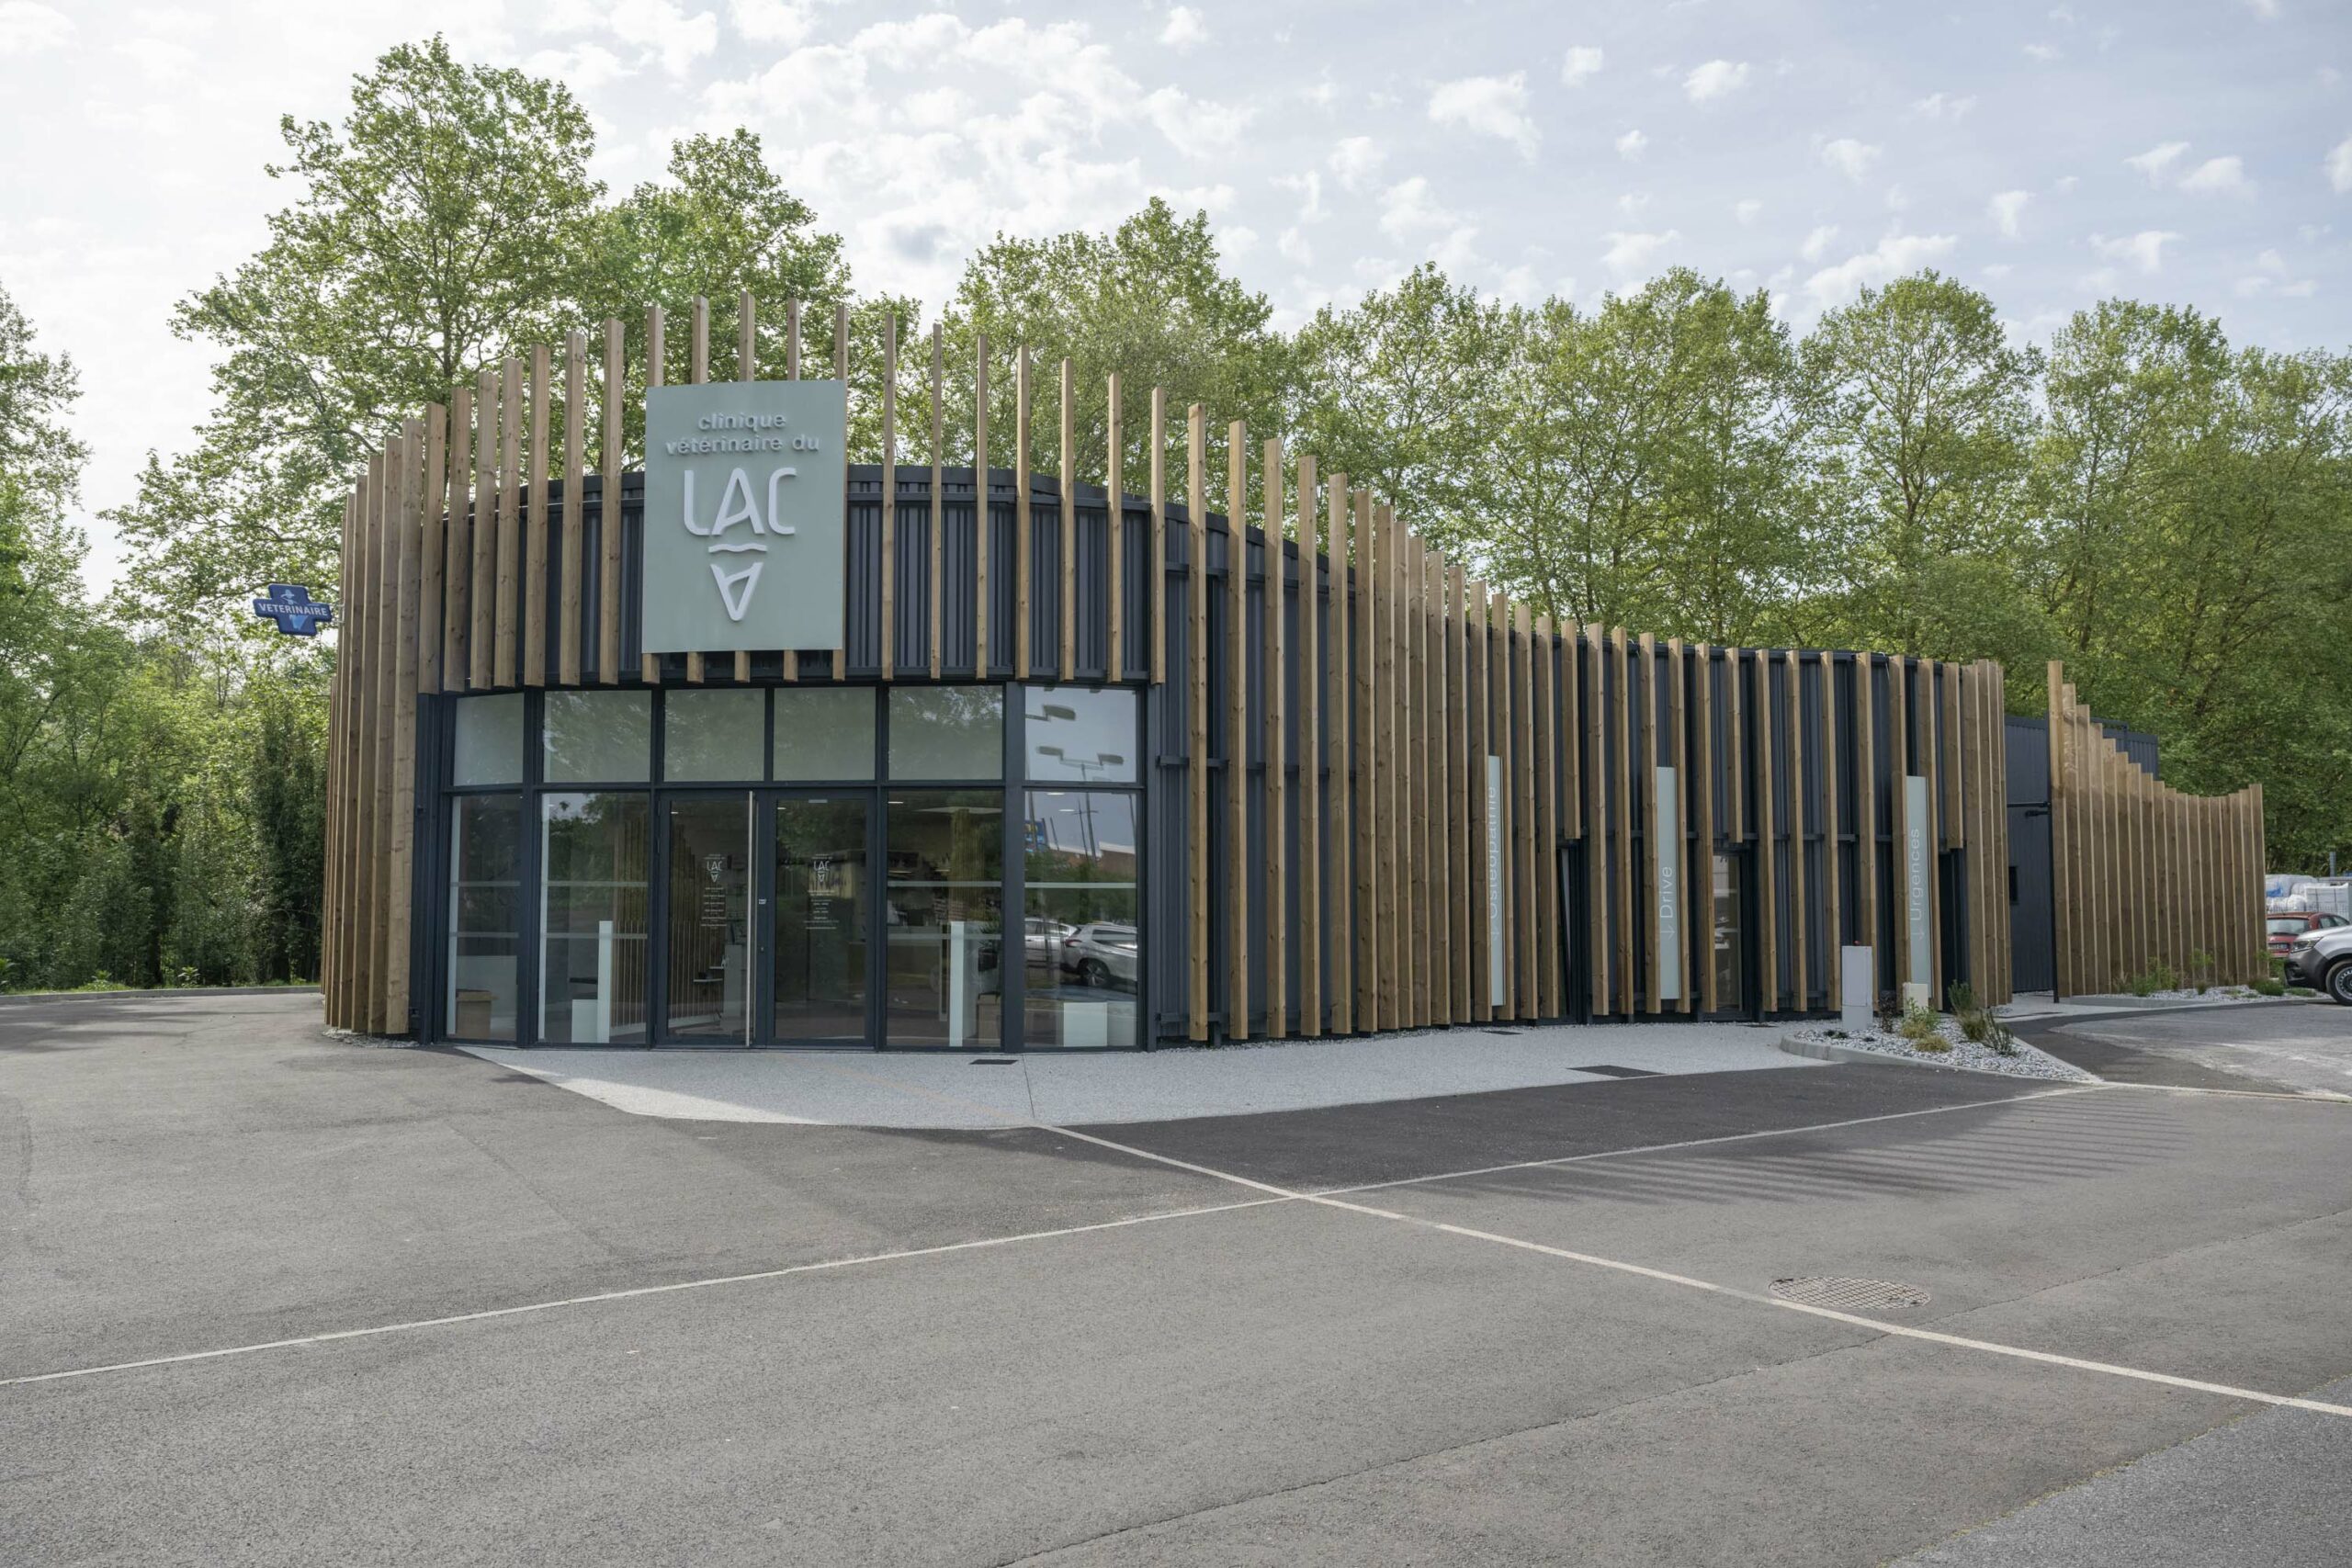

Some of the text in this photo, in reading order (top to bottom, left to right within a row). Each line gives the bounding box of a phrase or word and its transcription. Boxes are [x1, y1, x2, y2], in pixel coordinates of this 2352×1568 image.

[698, 412, 786, 432] clinique
[666, 434, 820, 455] vétérinaire du
[684, 468, 797, 536] LAC
[258, 603, 328, 615] VETERINAIRE
[707, 861, 722, 871] LAC
[813, 861, 830, 871] LAC
[1910, 829, 1923, 920] Urgences
[1659, 866, 1673, 918] Drive
